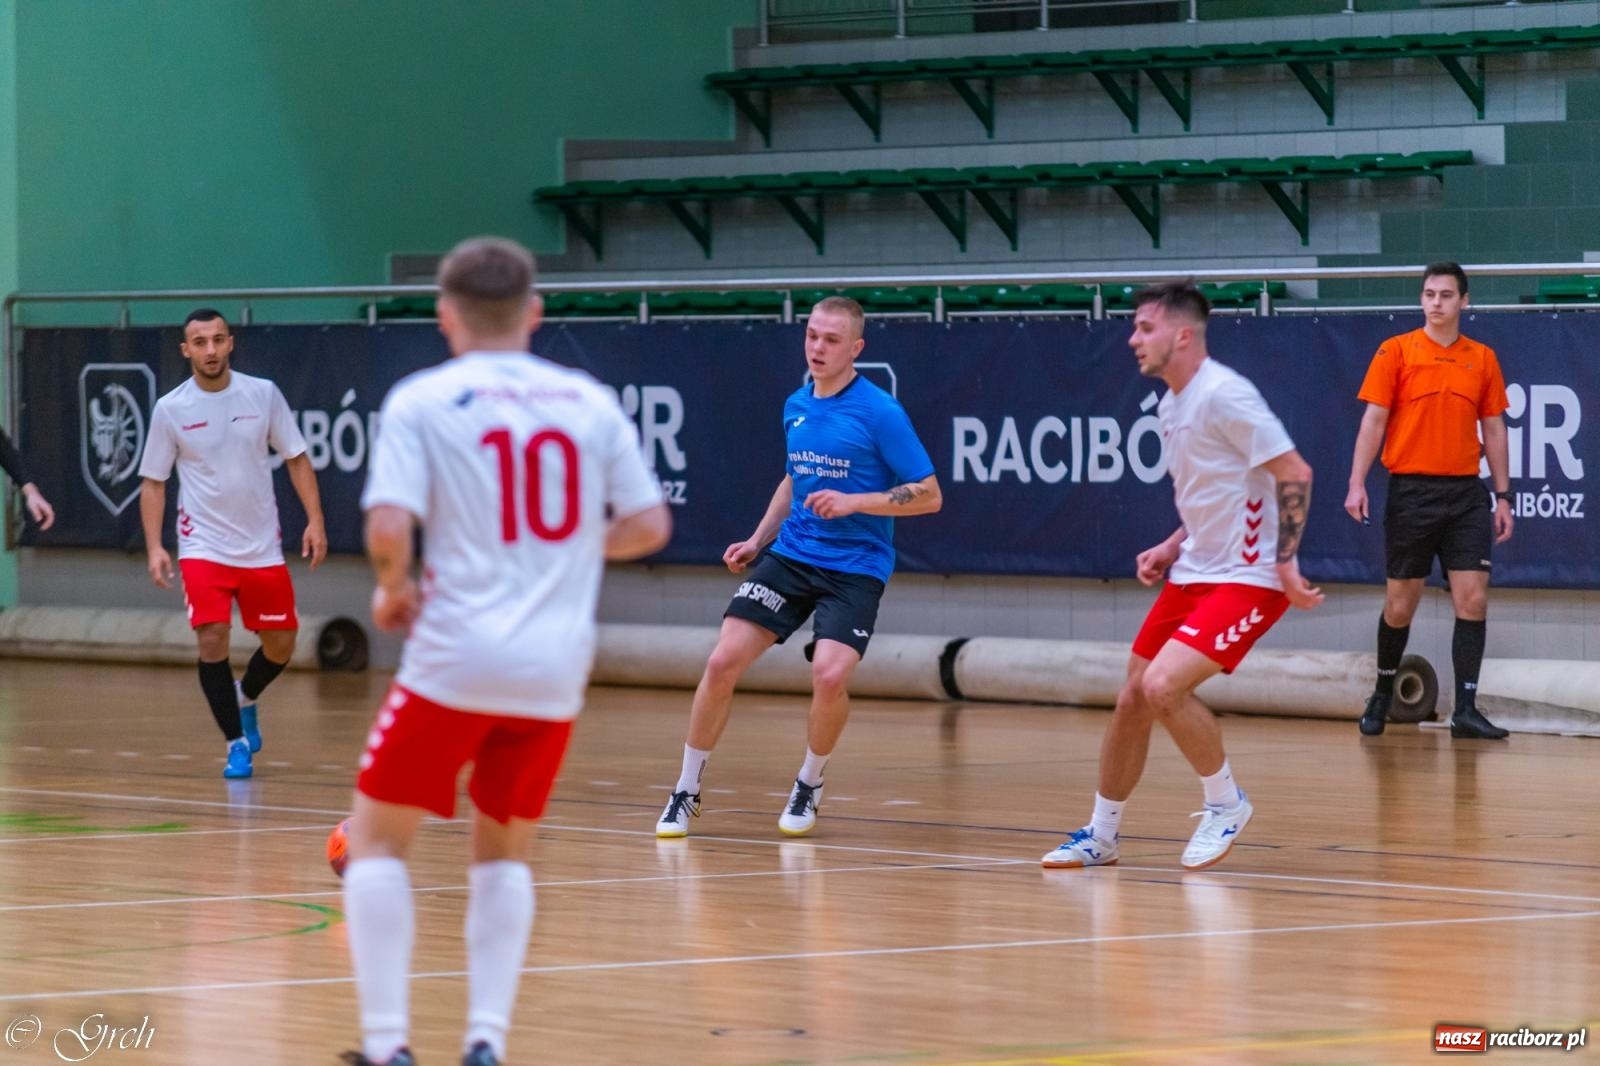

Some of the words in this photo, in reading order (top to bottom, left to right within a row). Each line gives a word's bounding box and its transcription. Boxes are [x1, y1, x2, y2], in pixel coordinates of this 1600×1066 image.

[952, 391, 1175, 484] RACIBÓ
[480, 427, 580, 544] 10
[816, 467, 848, 478] GmbH
[748, 584, 787, 613] SPORT
